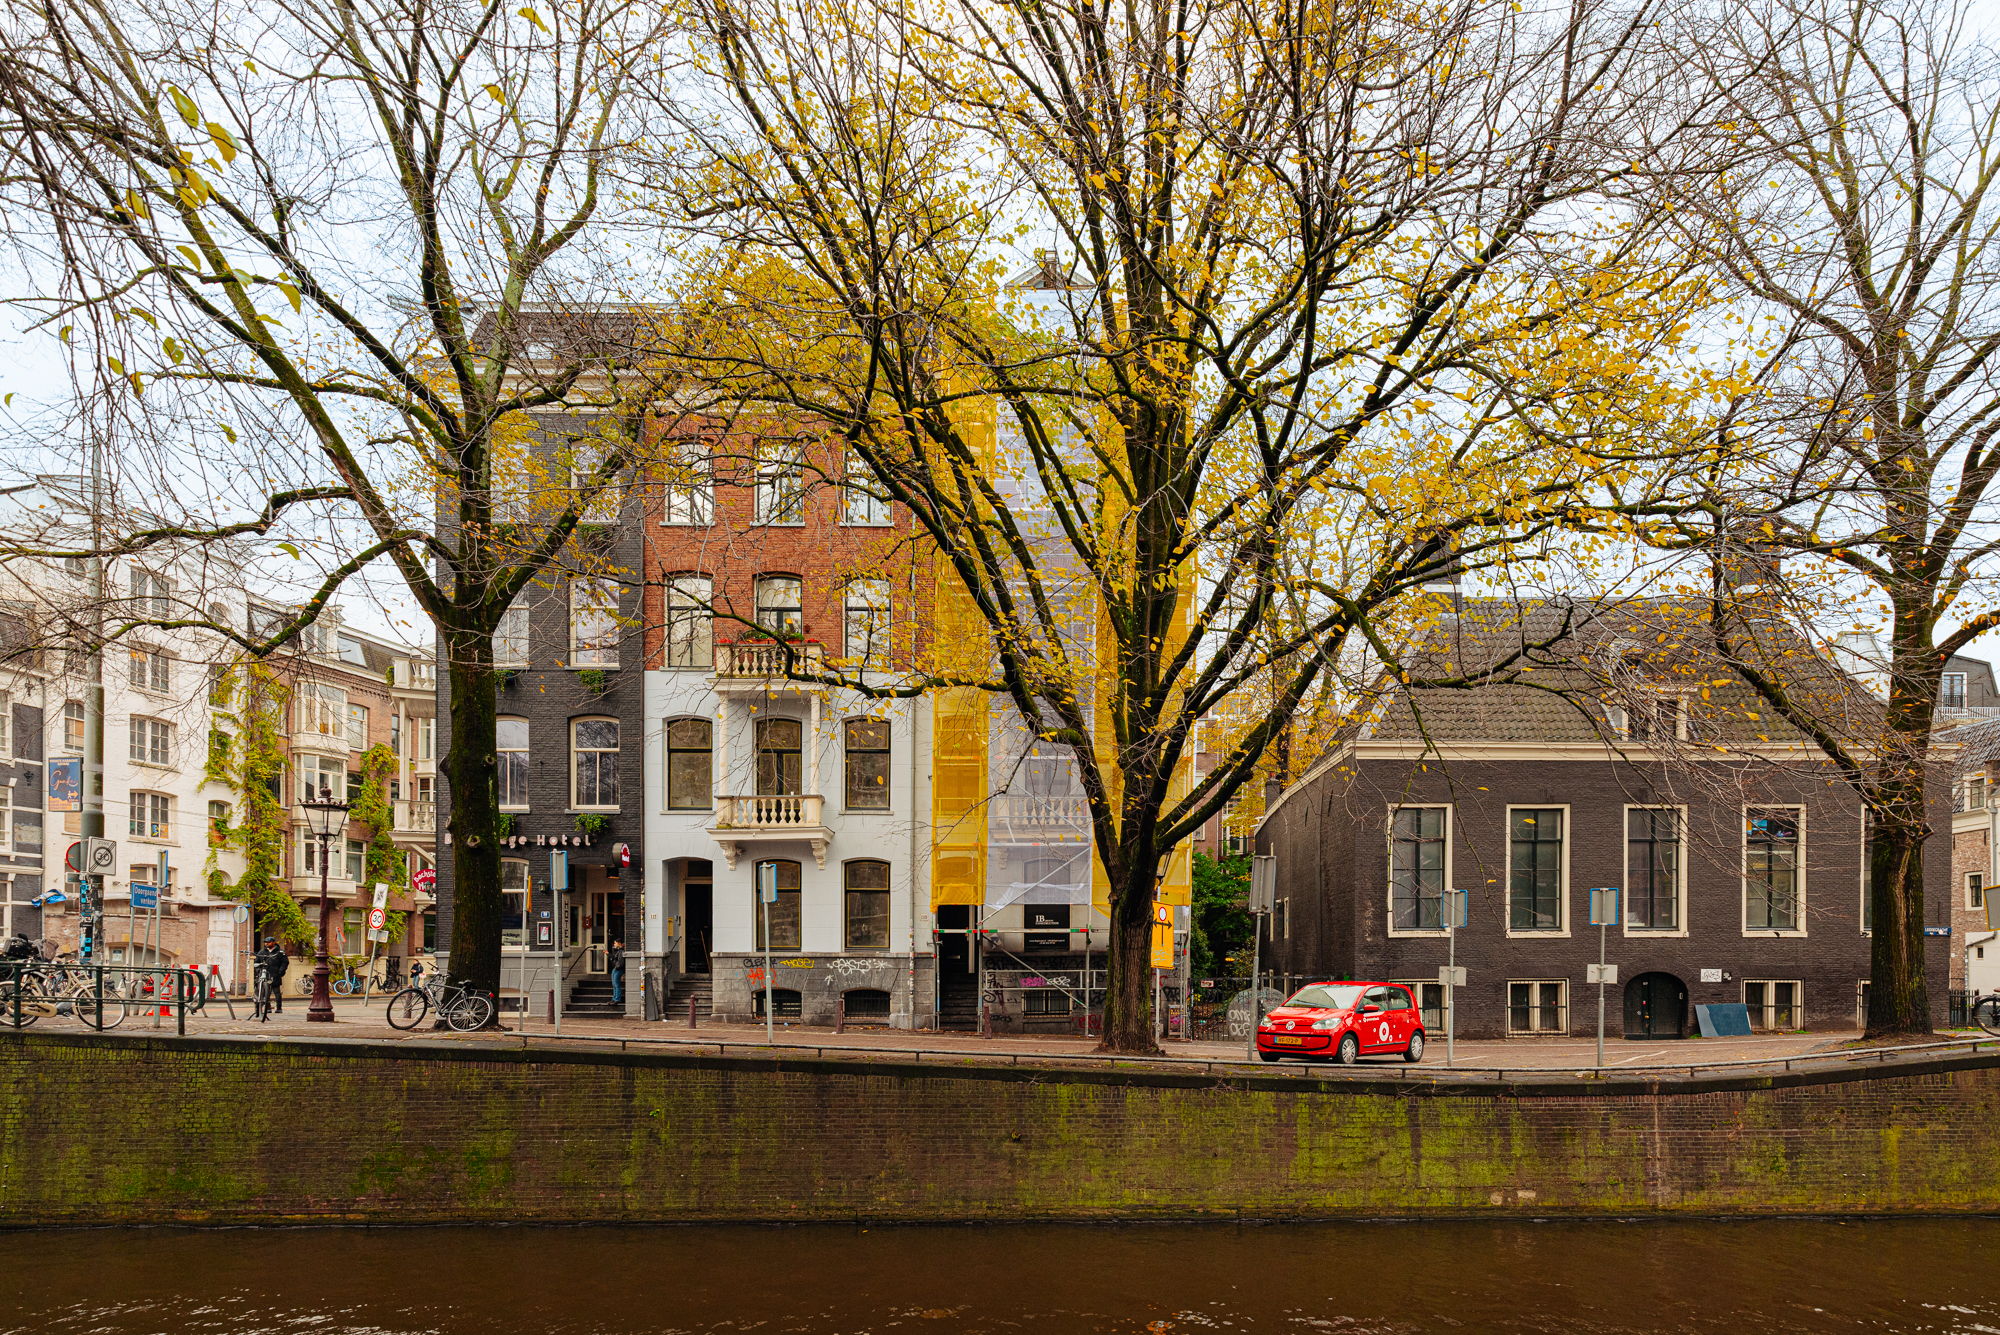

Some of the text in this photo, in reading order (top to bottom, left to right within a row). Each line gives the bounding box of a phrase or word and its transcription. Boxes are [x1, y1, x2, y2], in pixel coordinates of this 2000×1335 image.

[536, 834, 591, 846] Hotel
[97, 852, 110, 862] 30
[372, 914, 382, 924] 30
